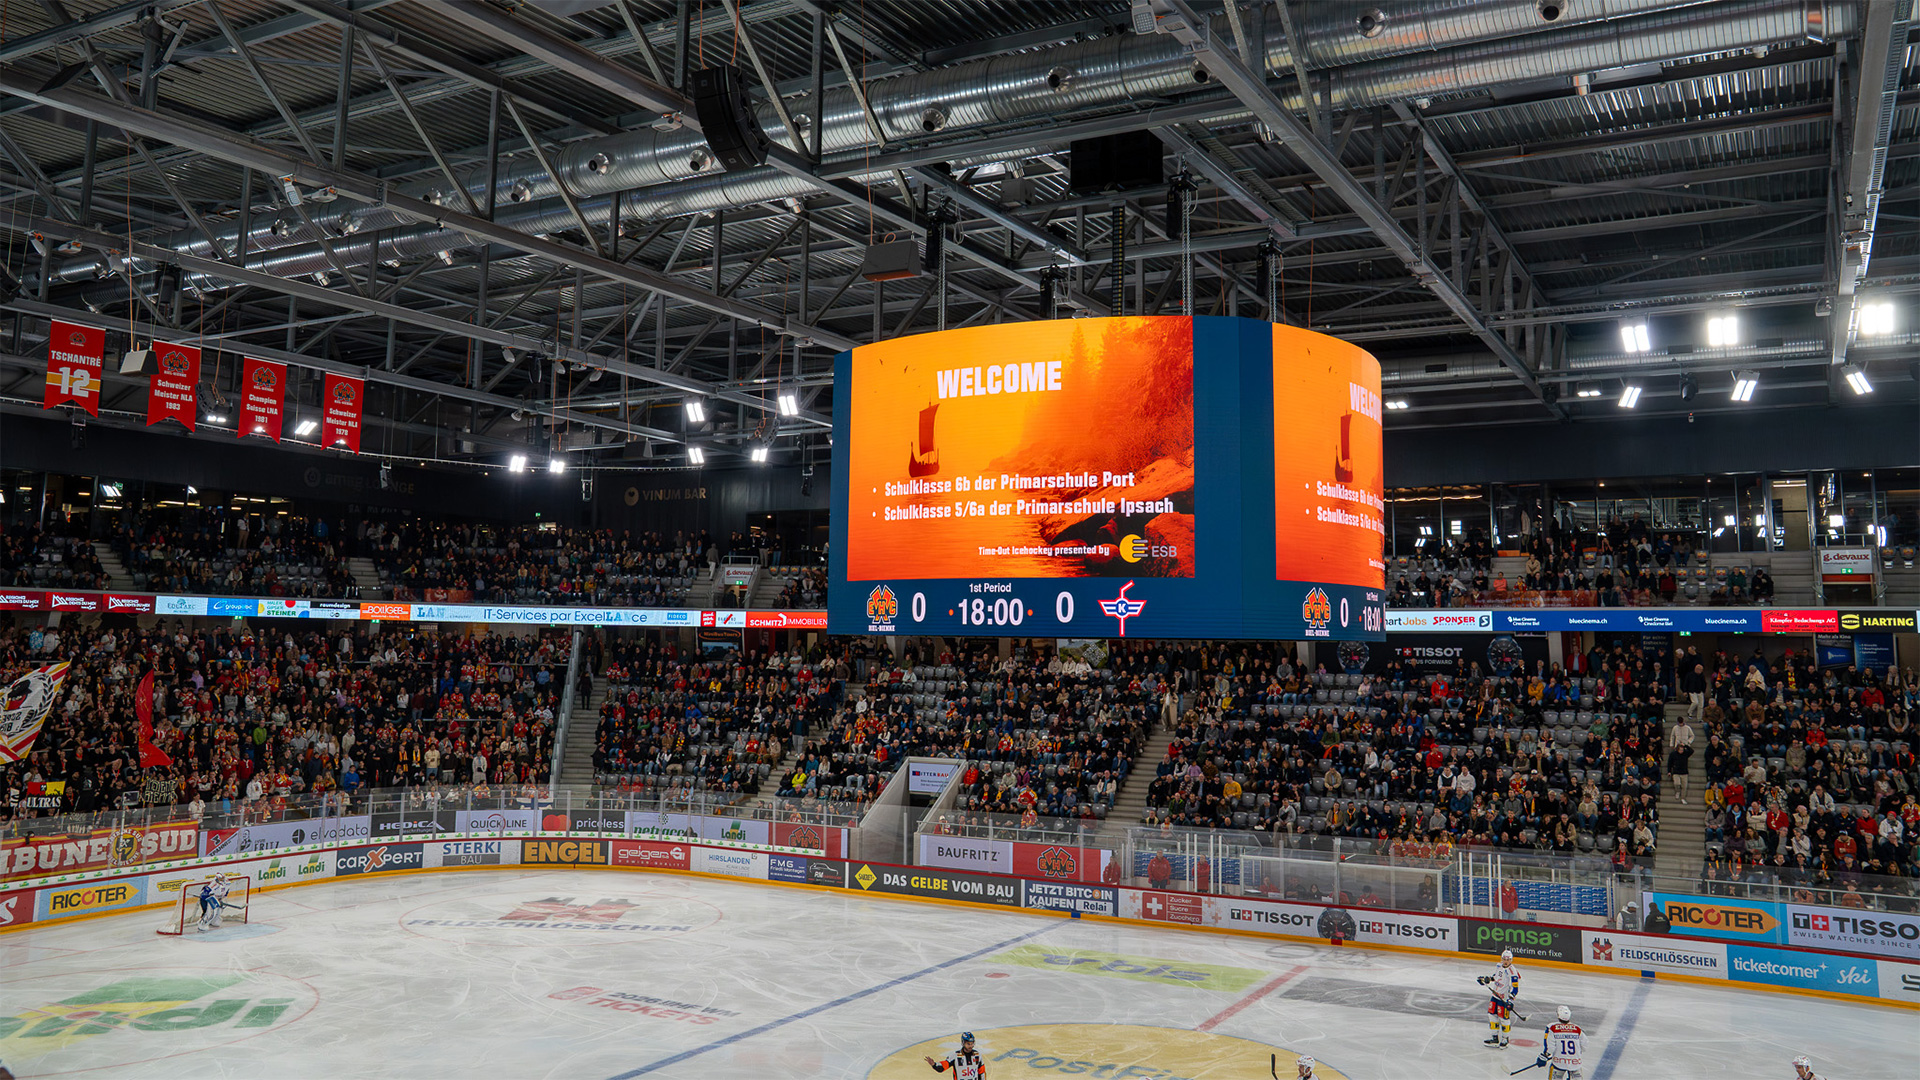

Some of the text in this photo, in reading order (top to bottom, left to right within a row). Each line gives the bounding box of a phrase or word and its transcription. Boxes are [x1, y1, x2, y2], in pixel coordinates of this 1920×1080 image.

[51, 350, 101, 367] TSCHANTRÉ
[59, 367, 90, 397] 12
[158, 379, 191, 391] Schweizer
[937, 361, 1062, 399] WELCOME
[154, 389, 193, 402] Meister NLA
[249, 394, 277, 405] Champion
[166, 402, 181, 411] 1983
[246, 404, 278, 416] Suisse LNA
[329, 408, 357, 419] Schweizer
[255, 415, 268, 424] 1981
[326, 417, 347, 427] Meister
[885, 471, 1136, 497] Schulklasse 6b der Primarschule Port
[1316, 480, 1359, 503] Schulklasse
[643, 488, 706, 500] VINUM BAR
[884, 498, 1174, 522] Schulklasse 5/6a der Primarschule Ipsach
[1317, 506, 1359, 527] Schulklasse
[978, 544, 1110, 557] Time-Out Icehockey presented by
[1151, 545, 1178, 558] ESB
[969, 583, 1012, 593] 1st Period
[869, 600, 898, 616] EHC
[912, 592, 926, 623] 0
[957, 598, 1024, 626] 18:00
[1056, 591, 1075, 623] 0
[1304, 604, 1330, 619] EHC
[1340, 598, 1349, 628] 0
[484, 609, 547, 621] IT-Services
[550, 611, 571, 623] par
[750, 619, 782, 627] SCHMITZ
[786, 617, 827, 626] IMMOBILIEN
[1433, 616, 1476, 625] SPONSER
[1863, 618, 1914, 627] HARTING
[1413, 648, 1463, 657] TISSOT
[27, 796, 62, 808] ULTRAS
[310, 822, 369, 842] elvadata
[576, 818, 624, 832] priceless
[138, 827, 192, 854] SUD
[721, 826, 746, 841] Landi
[443, 841, 501, 855] STERKI
[790, 836, 820, 849] EHC
[461, 855, 482, 865] BAU
[524, 842, 605, 863] ENGEL
[708, 854, 751, 865] HIRSLANDEN
[937, 846, 999, 863] BAUFRITZ
[298, 861, 325, 876] Landi
[770, 858, 794, 868] FMG
[1038, 857, 1076, 873] EHC
[258, 866, 286, 881] Landi
[883, 873, 1015, 899] DAS GELBE VOM BAU
[1029, 883, 1113, 901] JETZT BITCOIN
[52, 886, 127, 911] RICOTER
[1029, 895, 1075, 909] KAUFEN
[1169, 896, 1192, 904] Zucker
[1083, 901, 1107, 912] Relai
[1254, 911, 1314, 928] TISSOT
[1668, 905, 1764, 930] RICOTER
[407, 919, 693, 932] FELDSCHLÖSSCHEN
[1385, 923, 1450, 940] TISSOT
[1477, 925, 1552, 946] pemsa
[1793, 931, 1912, 949] SWISS WATCHES SINCE
[1548, 949, 1562, 958] fixe
[1620, 947, 1718, 969] FELDSCHLÖSSCHEN
[1733, 957, 1873, 986] ticketcorner ski
[587, 997, 720, 1025] TICKETS
[1561, 1040, 1576, 1056] 19
[961, 1066, 977, 1078] sky
